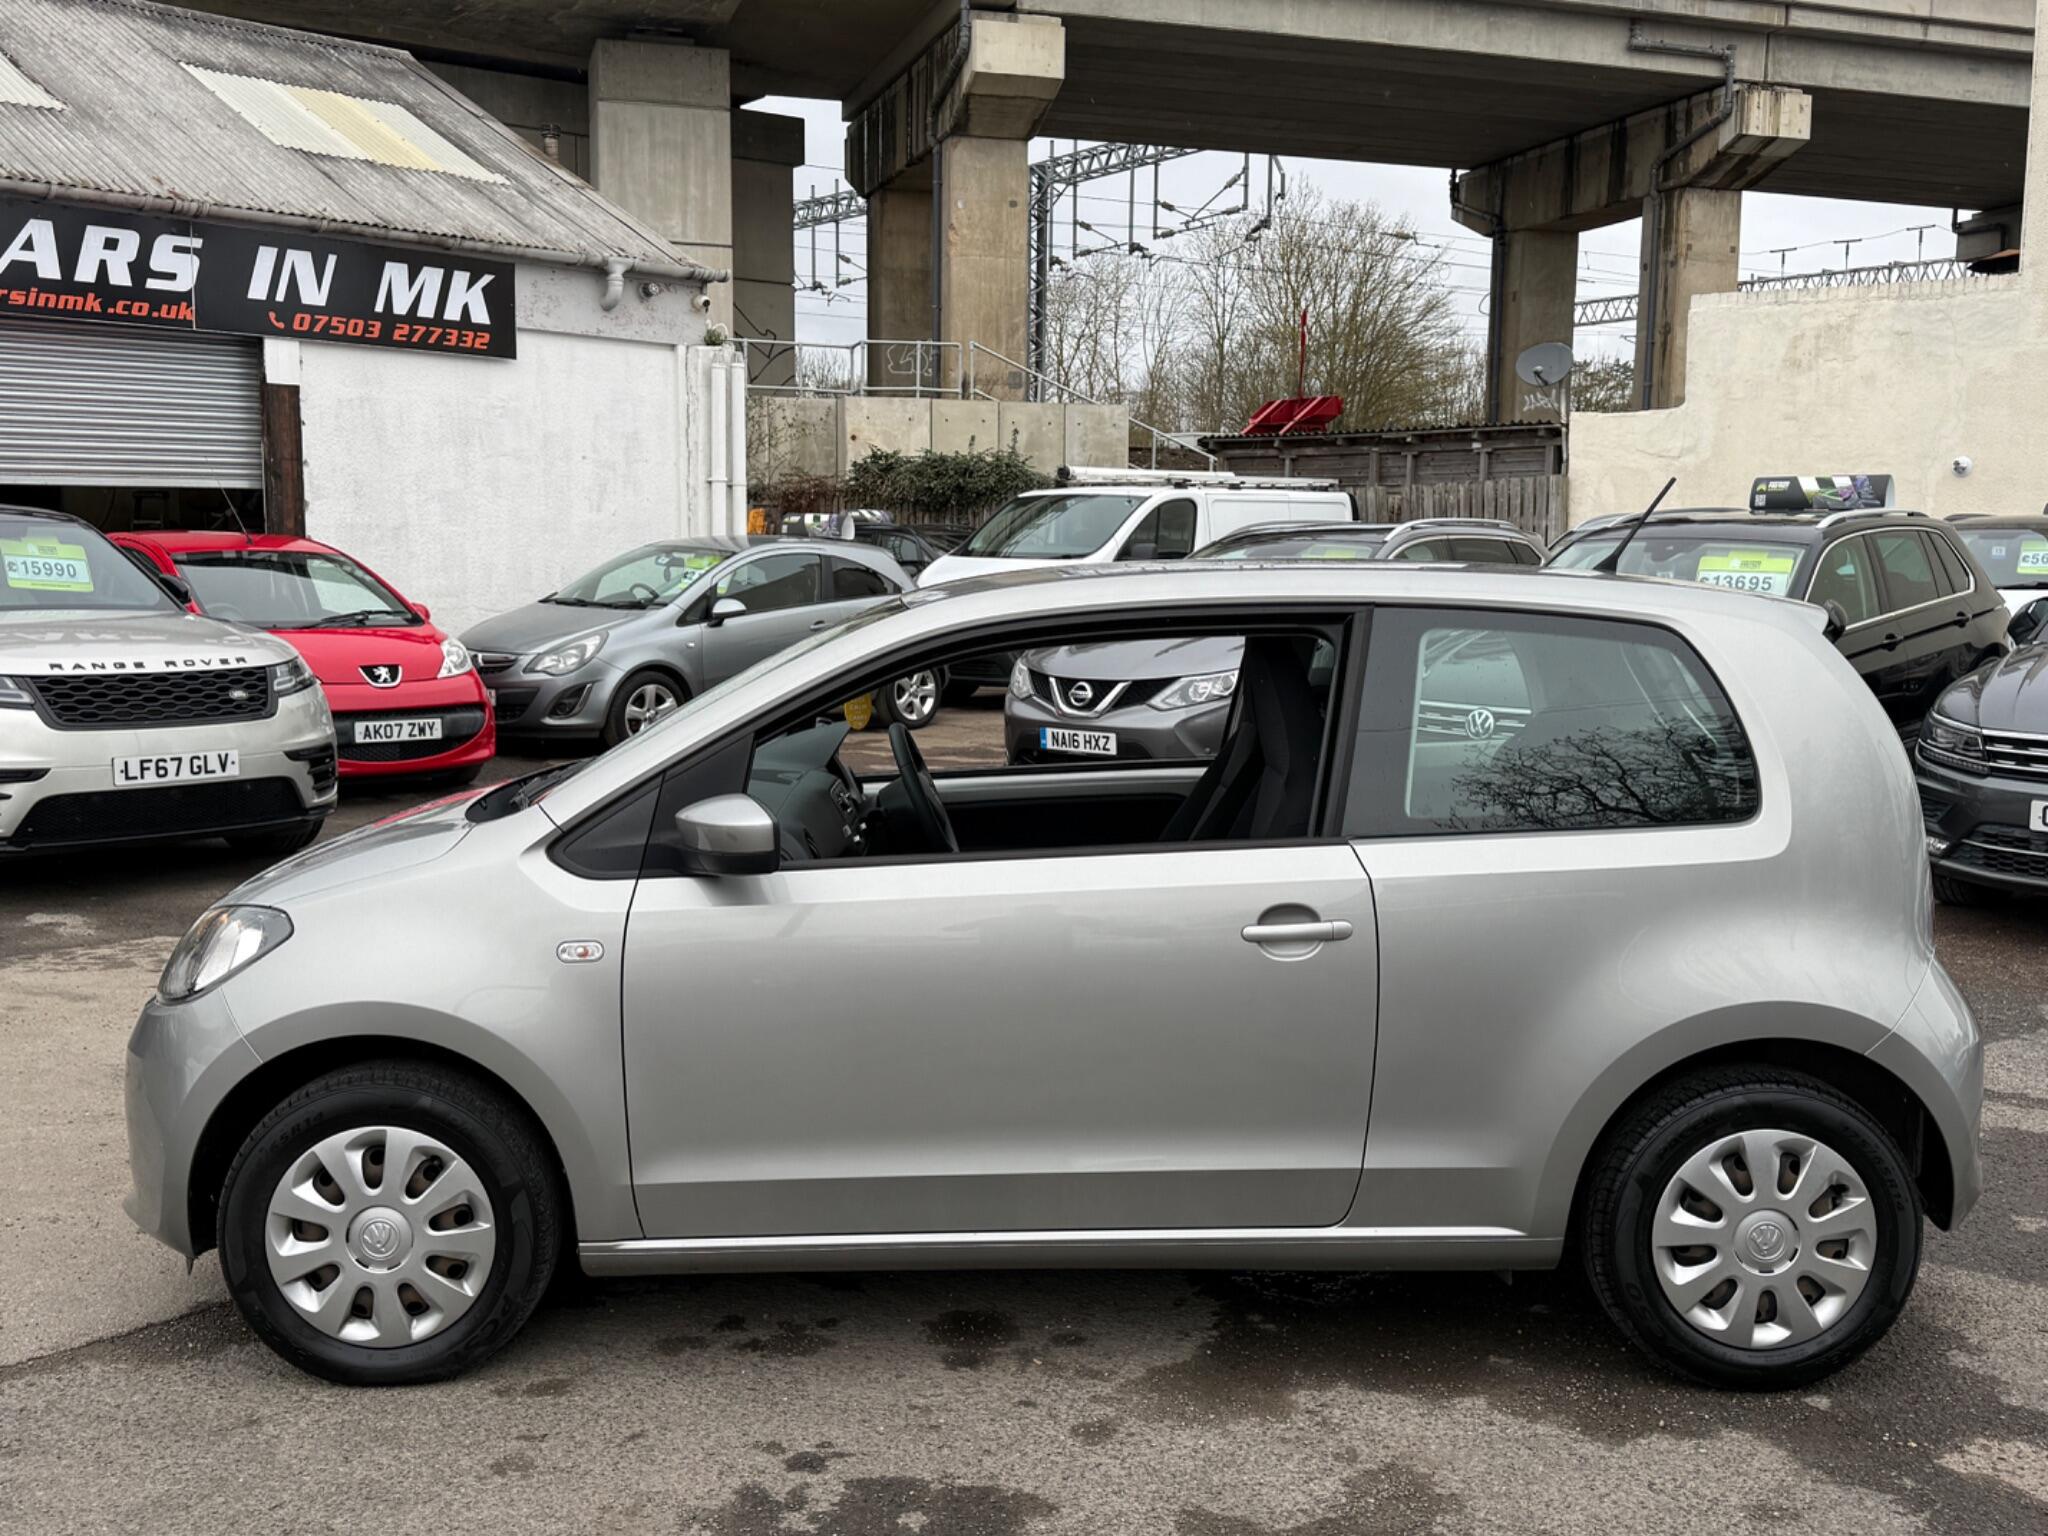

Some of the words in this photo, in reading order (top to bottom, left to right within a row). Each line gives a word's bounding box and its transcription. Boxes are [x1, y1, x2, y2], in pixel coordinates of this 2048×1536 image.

[0, 219, 203, 292] ARS
[247, 245, 338, 307] IN
[374, 261, 496, 325] MK
[292, 312, 382, 339] 07503
[392, 323, 491, 350] 277332
[7, 560, 77, 578] £15990
[49, 661, 146, 671] RANGE
[164, 656, 247, 667] ROVER
[363, 723, 403, 740] AK07
[408, 721, 436, 738] ZWY
[1051, 731, 1080, 749] NA16
[1083, 733, 1111, 752] HXZ
[124, 756, 183, 781] LF67
[189, 753, 229, 776] GLV
